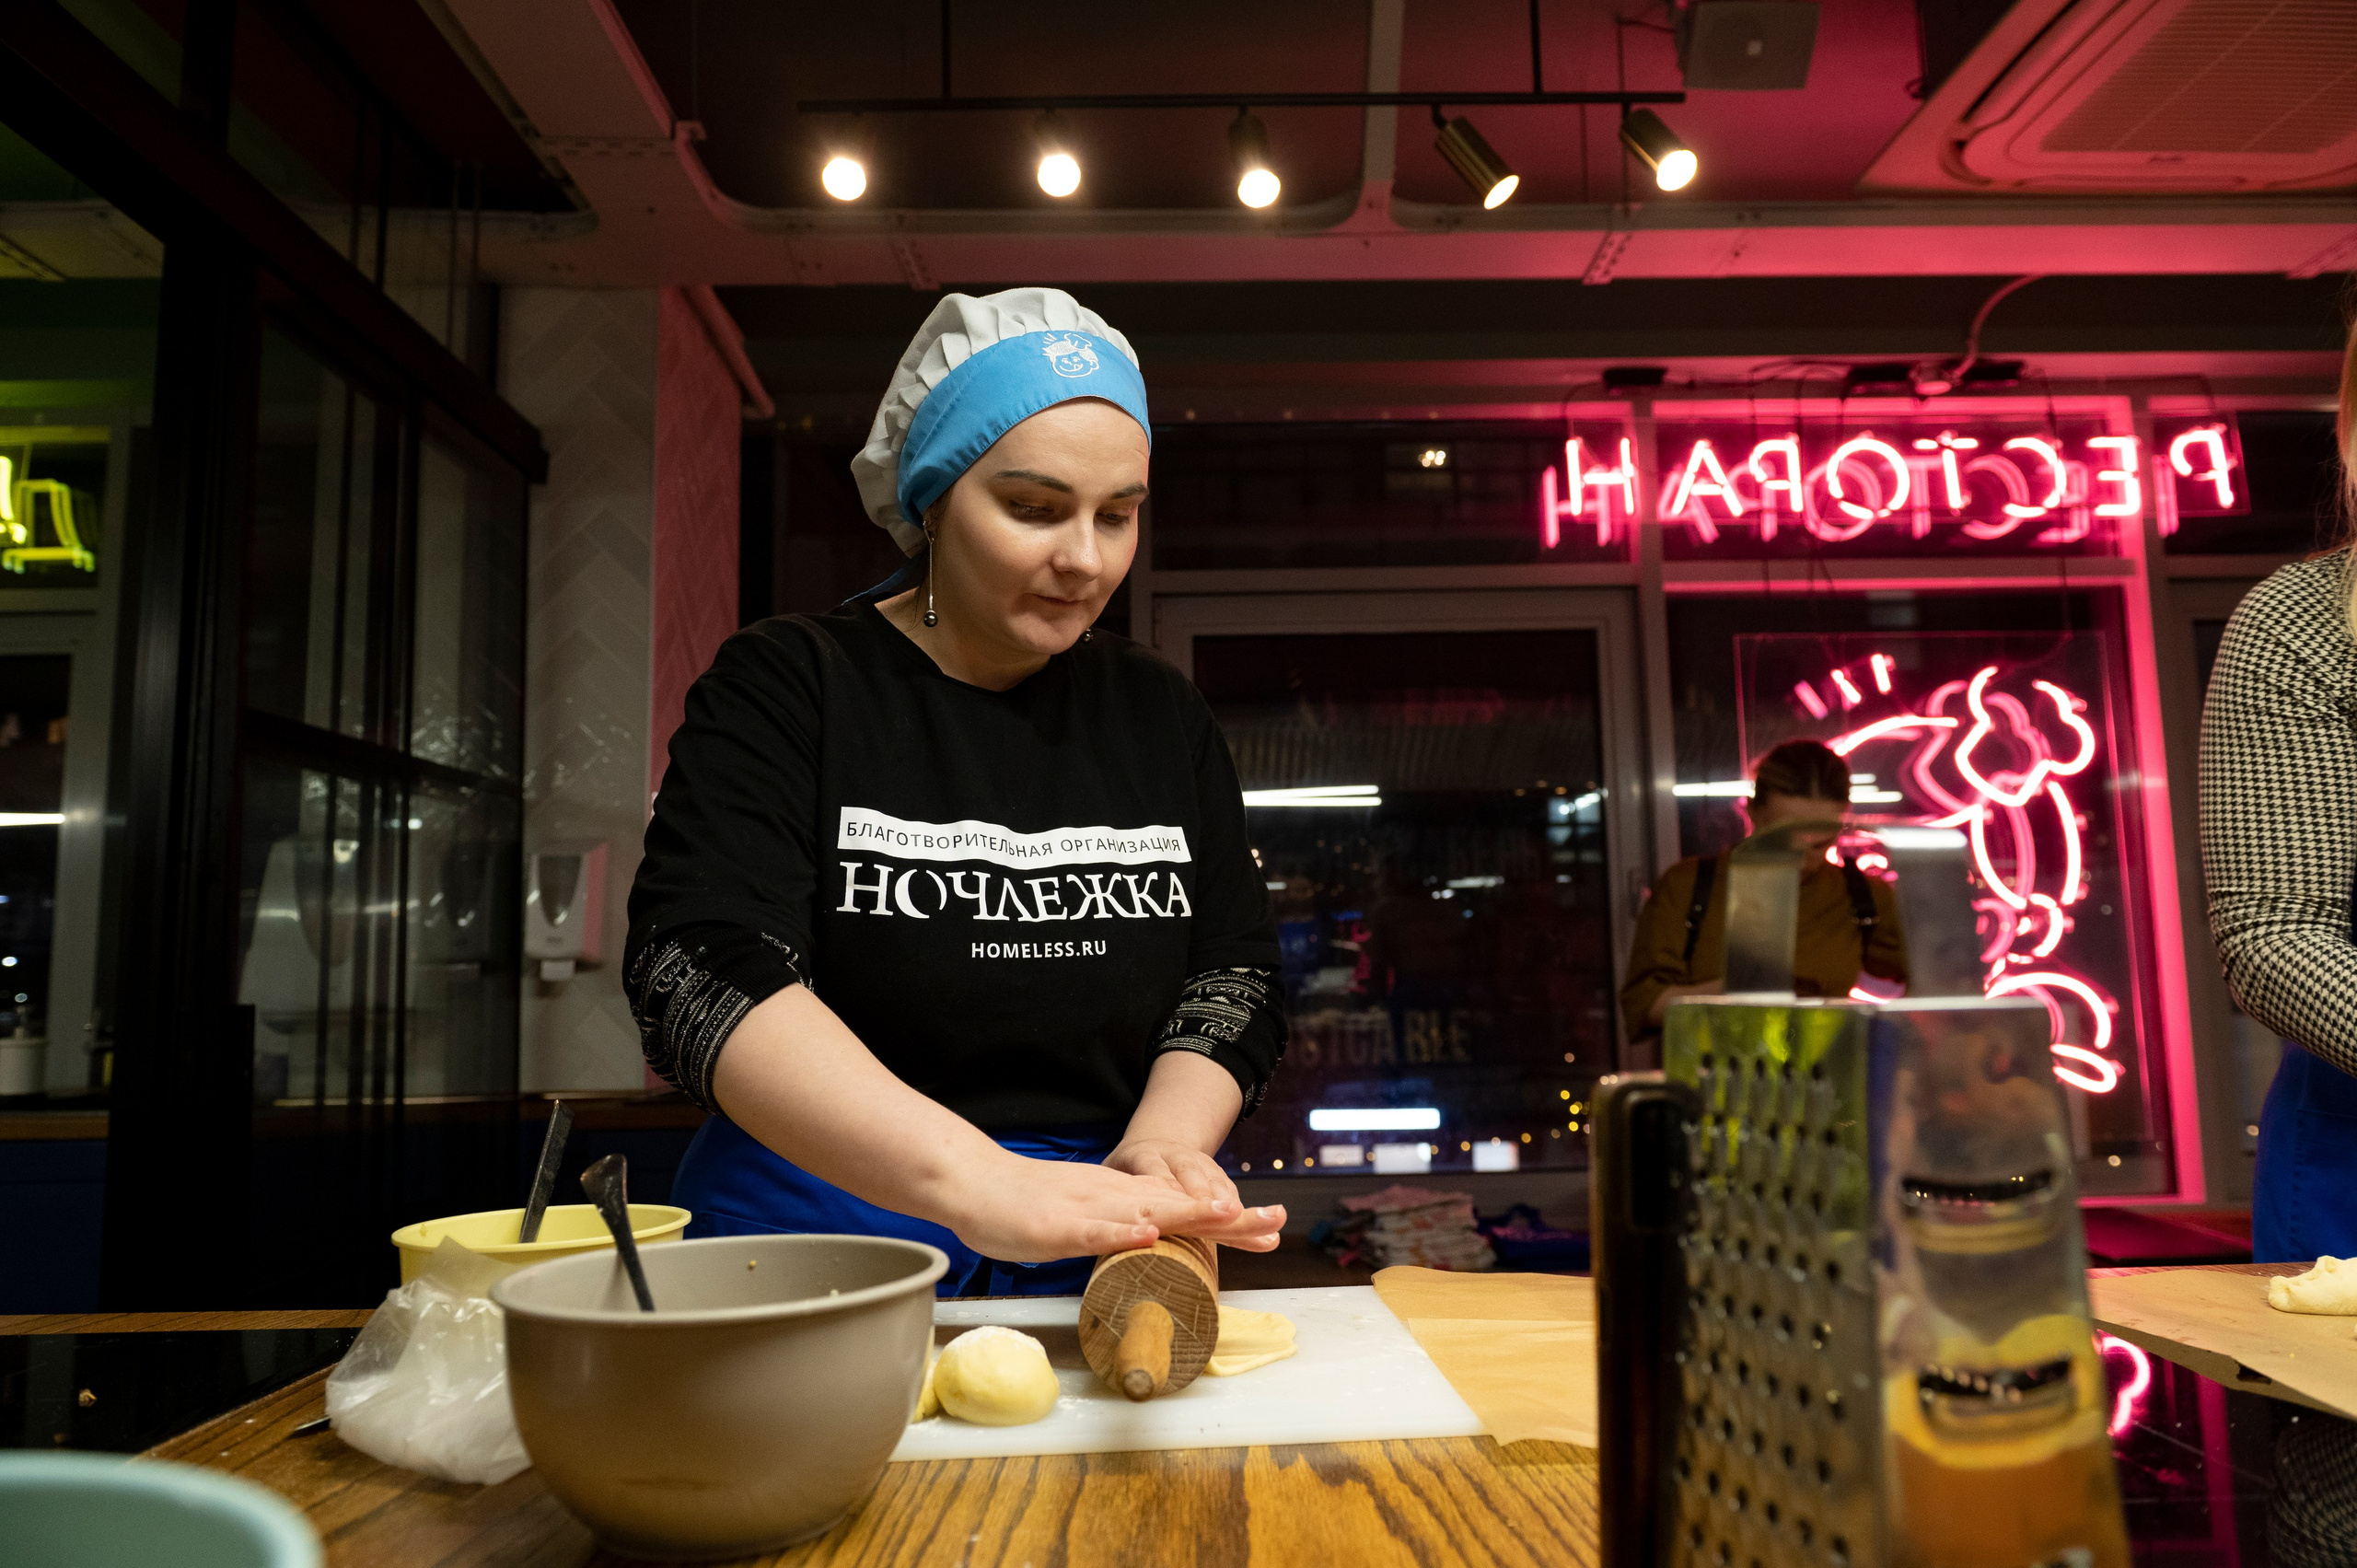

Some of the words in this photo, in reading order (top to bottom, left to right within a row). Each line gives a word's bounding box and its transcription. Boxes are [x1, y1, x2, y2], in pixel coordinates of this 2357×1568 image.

[846, 821, 1053, 858] БЛАГОТВОРИТЕЛЬНАЯ
[1060, 837, 1181, 854] ОРГАНИЗАЦИЯ
[836, 861, 1192, 922] НОЧЛЕЖКА
[971, 940, 1108, 958] HOMELESS.RU
